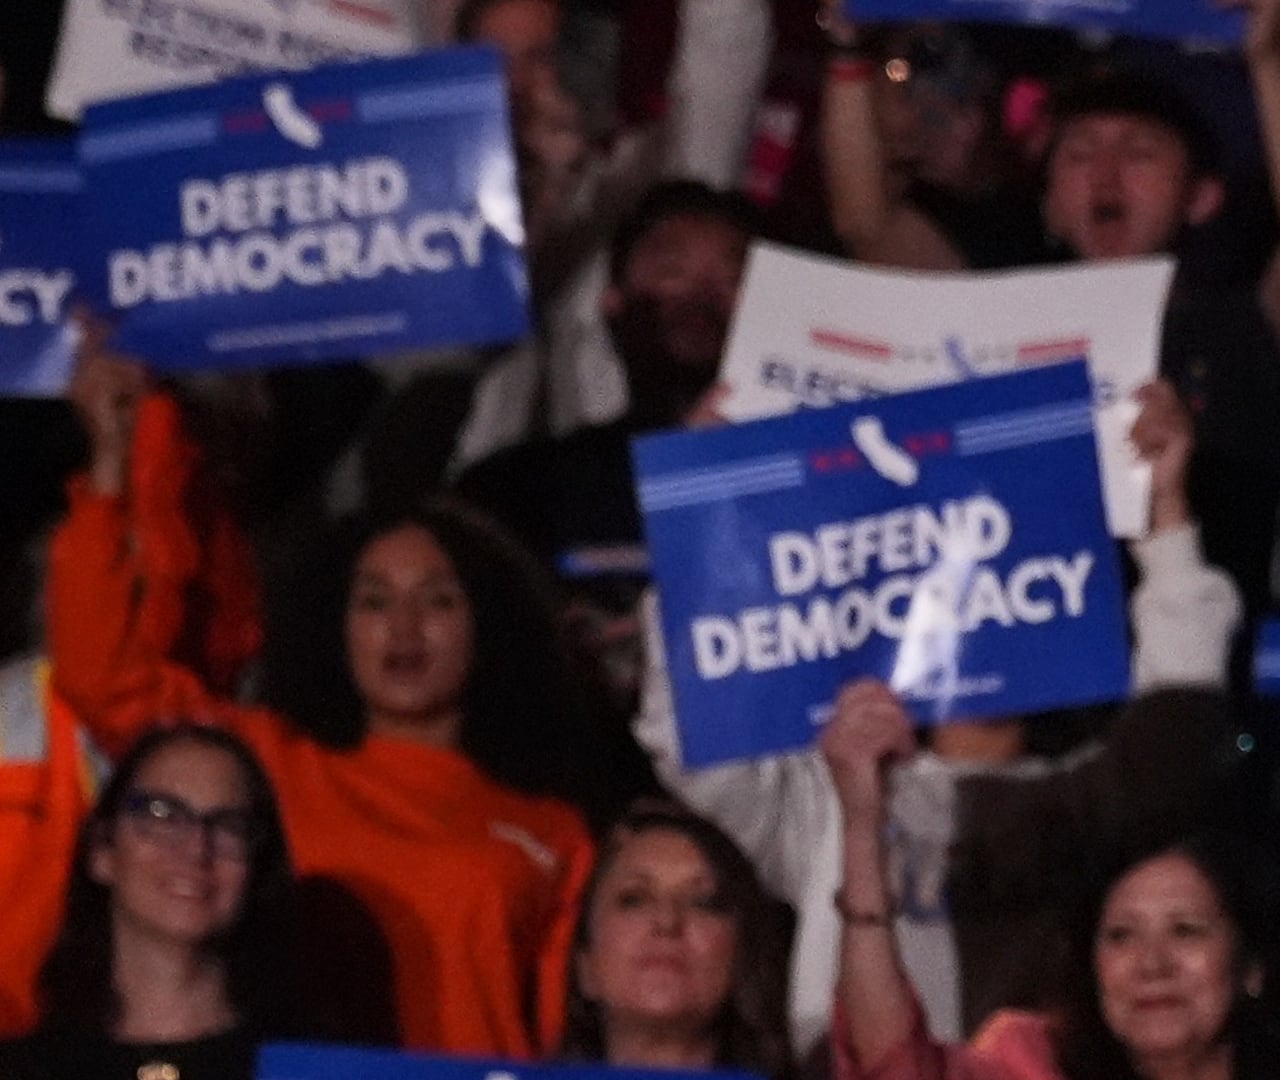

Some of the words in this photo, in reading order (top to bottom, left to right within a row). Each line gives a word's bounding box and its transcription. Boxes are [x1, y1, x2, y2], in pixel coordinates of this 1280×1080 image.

[180, 156, 407, 238] DEFEND
[109, 211, 485, 308] DEMOCRACY
[769, 496, 1012, 597] DEFEND
